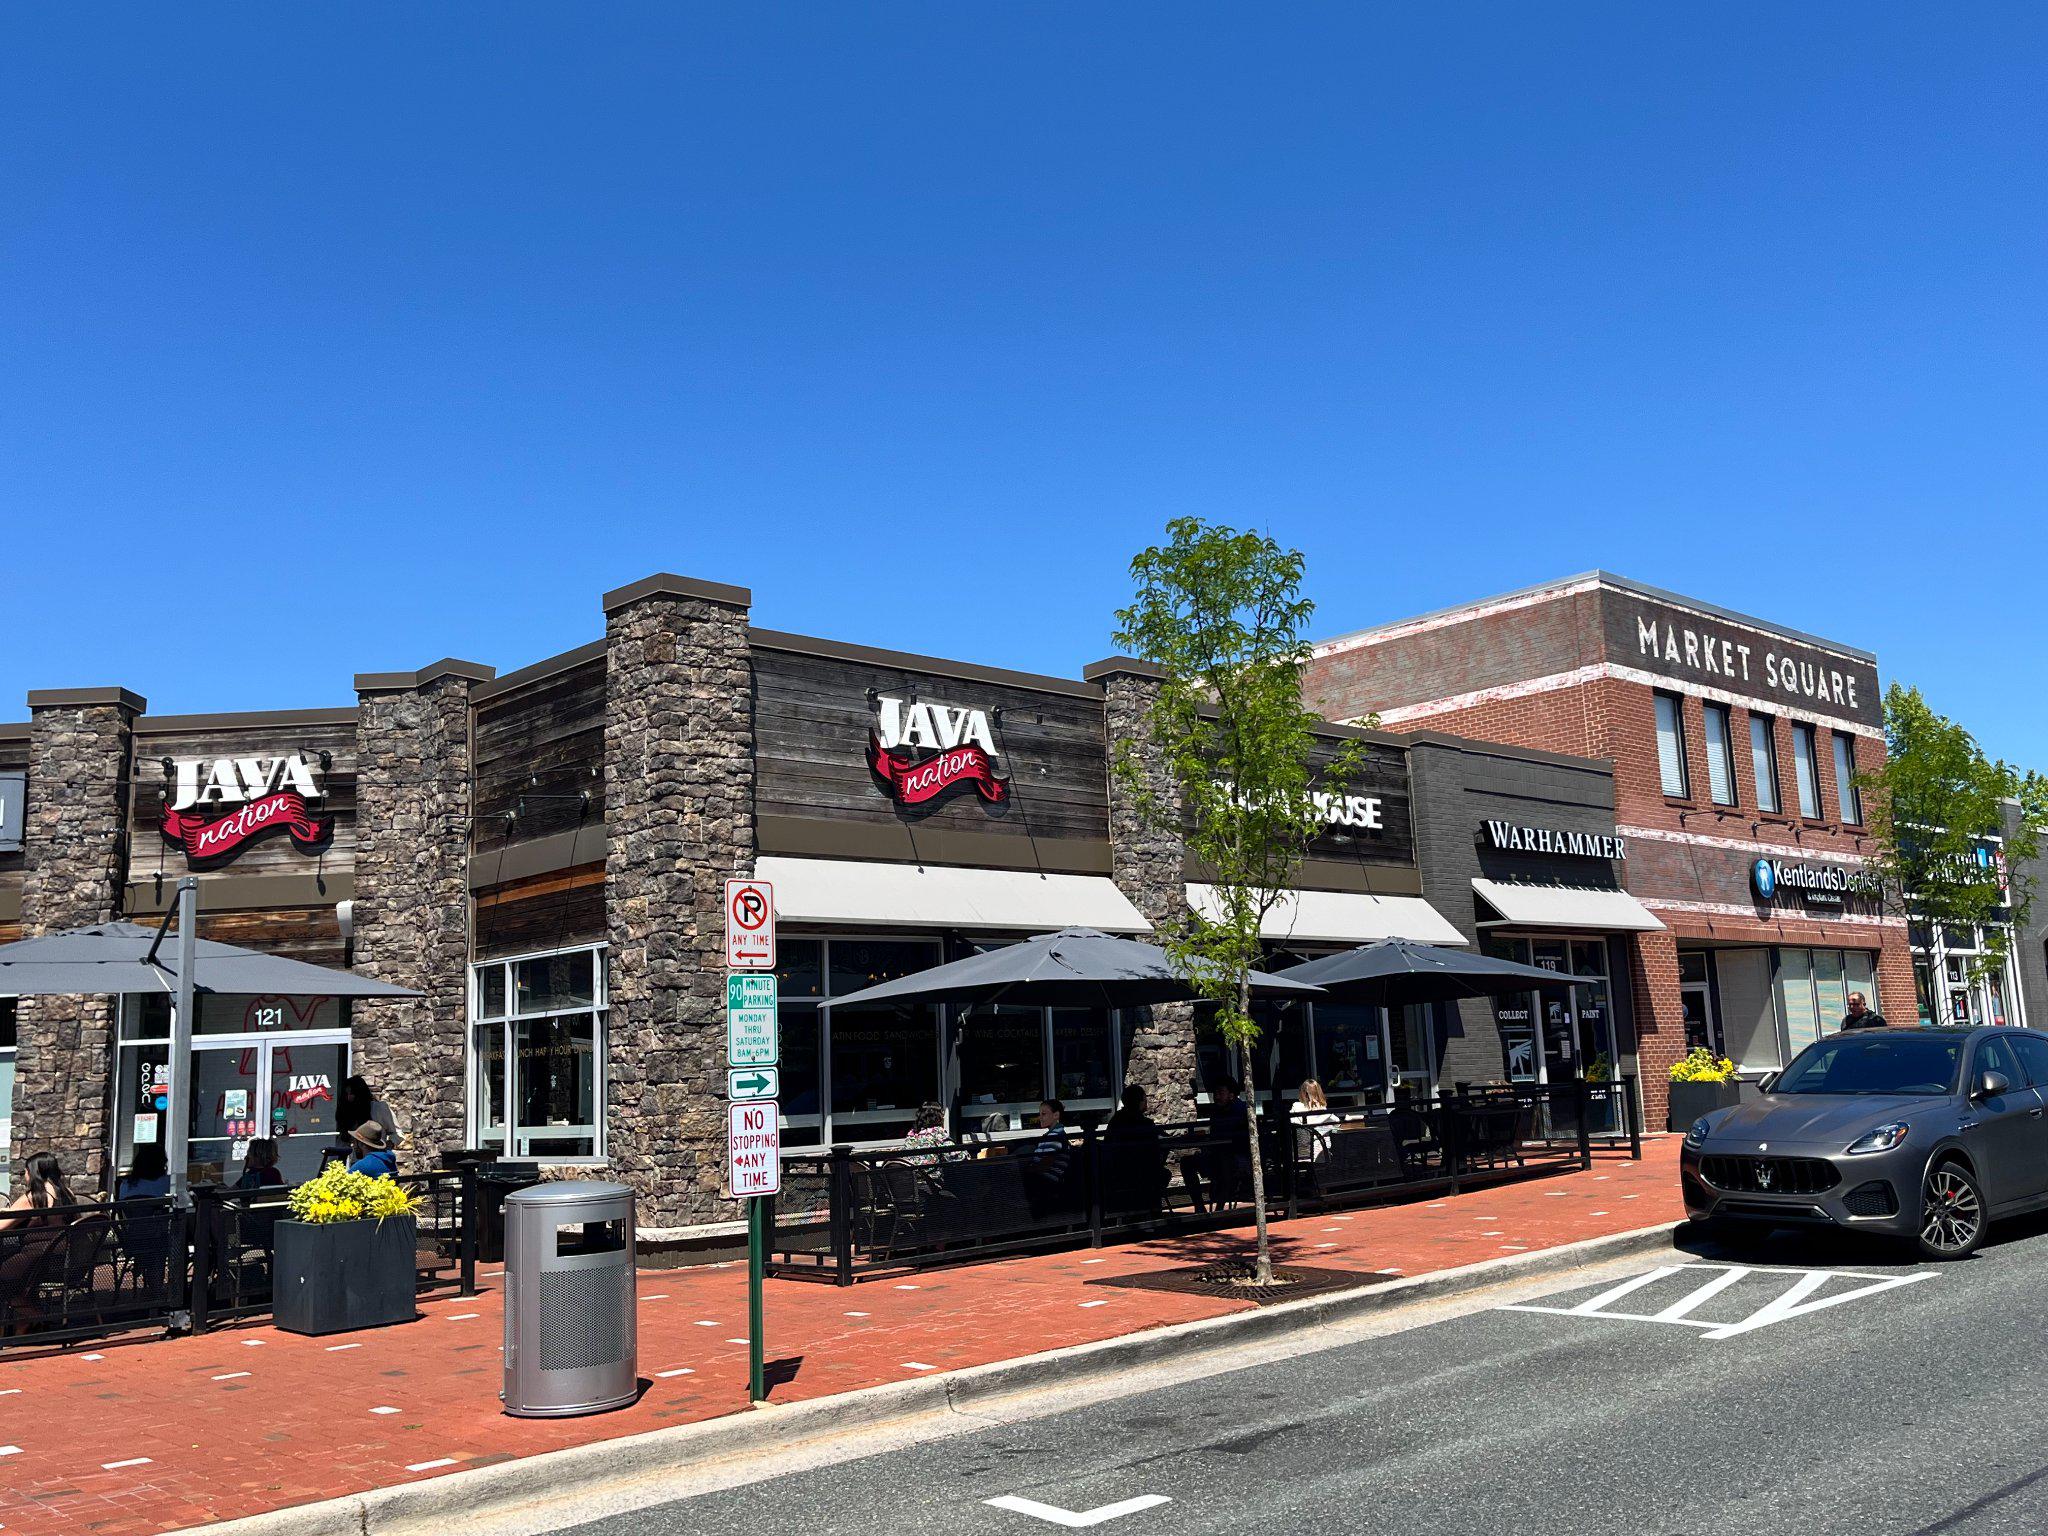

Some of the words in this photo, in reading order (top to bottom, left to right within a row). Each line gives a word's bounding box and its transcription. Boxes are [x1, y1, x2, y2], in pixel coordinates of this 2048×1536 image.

[1637, 616, 1750, 681] MARKET
[1765, 652, 1859, 709] SQUARE
[877, 696, 999, 757] JAVA
[906, 751, 977, 795] nation
[171, 755, 320, 811] JAVA
[198, 794, 290, 850] nation
[1488, 820, 1627, 860] WARHAMMER
[732, 934, 747, 946] ANY
[752, 934, 770, 946] TIME
[1540, 960, 1557, 972] 119
[729, 983, 743, 1001] 90
[745, 979, 771, 991] MINUTE
[743, 994, 774, 1006] PARKING
[254, 1008, 282, 1026] 121
[738, 1013, 767, 1023] MONDAY
[1498, 1010, 1529, 1020] COLLECT
[1581, 1009, 1600, 1019] PAINT
[744, 1025, 762, 1034] THRU
[736, 1036, 770, 1046] SATURDAY
[737, 1047, 770, 1057] 8AM-6PM
[289, 1074, 331, 1092] JAVA
[743, 1111, 764, 1131] NO
[732, 1132, 776, 1150] STOPPING
[743, 1153, 766, 1168] ANY
[742, 1172, 769, 1187] TIME
